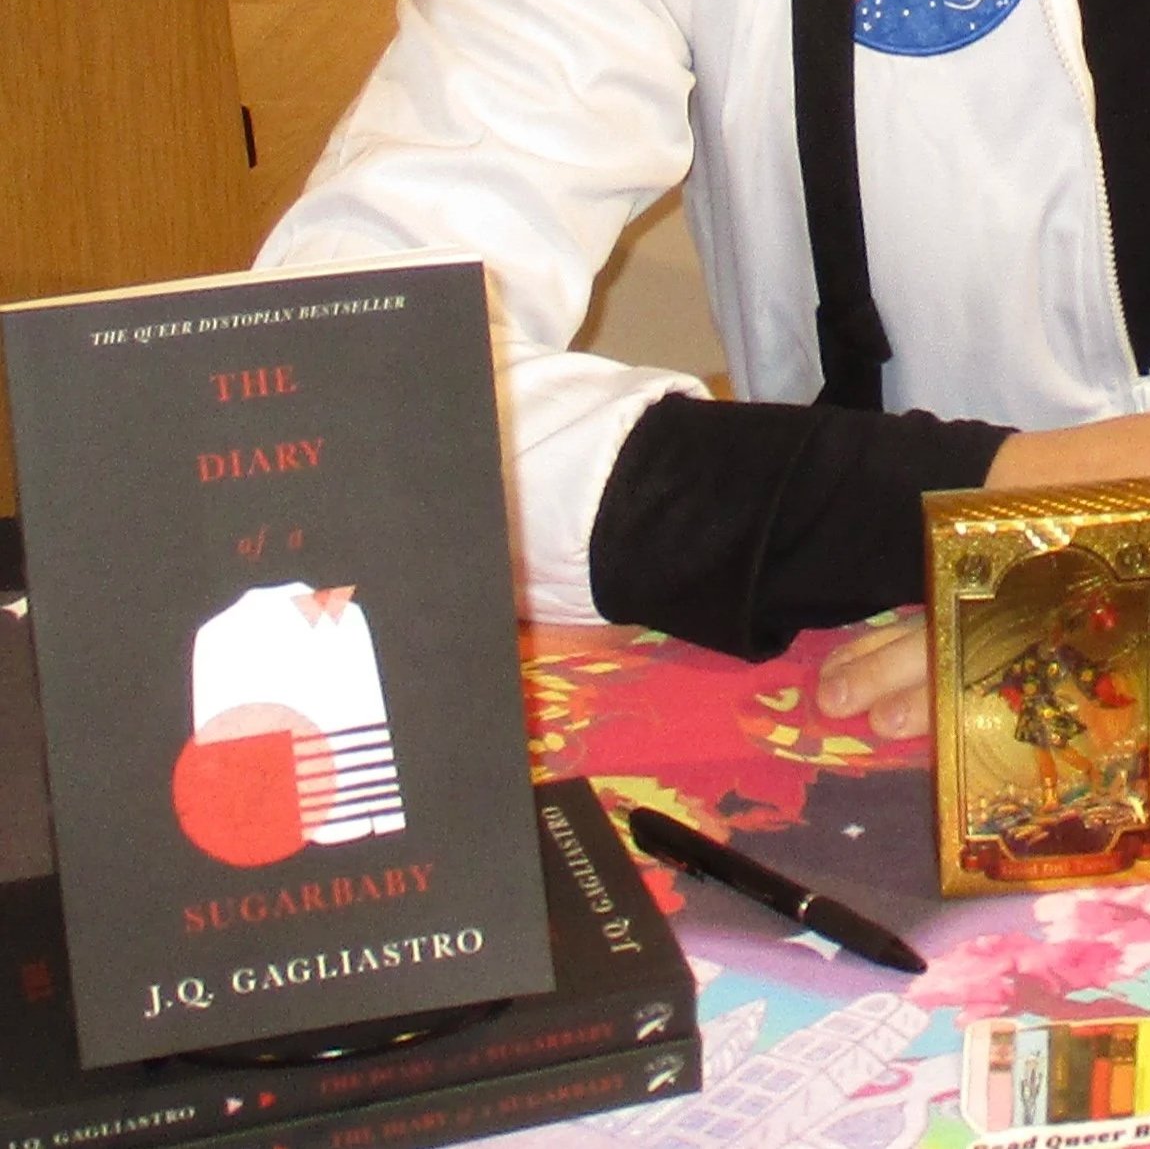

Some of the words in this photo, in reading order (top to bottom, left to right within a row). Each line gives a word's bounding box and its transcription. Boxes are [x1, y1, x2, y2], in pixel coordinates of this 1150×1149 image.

[90, 329, 127, 347] THE
[134, 320, 193, 343] QUEER
[200, 307, 293, 334] DYSTOPIAN
[299, 296, 406, 321] BESTSELLER
[210, 366, 297, 402] THE
[197, 438, 324, 483] DIARY
[542, 806, 614, 914] GAGLIASTRO
[183, 862, 436, 933] SUGARBABY
[144, 977, 214, 1019] J.Q.
[232, 927, 485, 995] GAGLIASTRO
[53, 1106, 196, 1146] GAGLIASTRO
[1045, 1128, 1126, 1148] Queer
